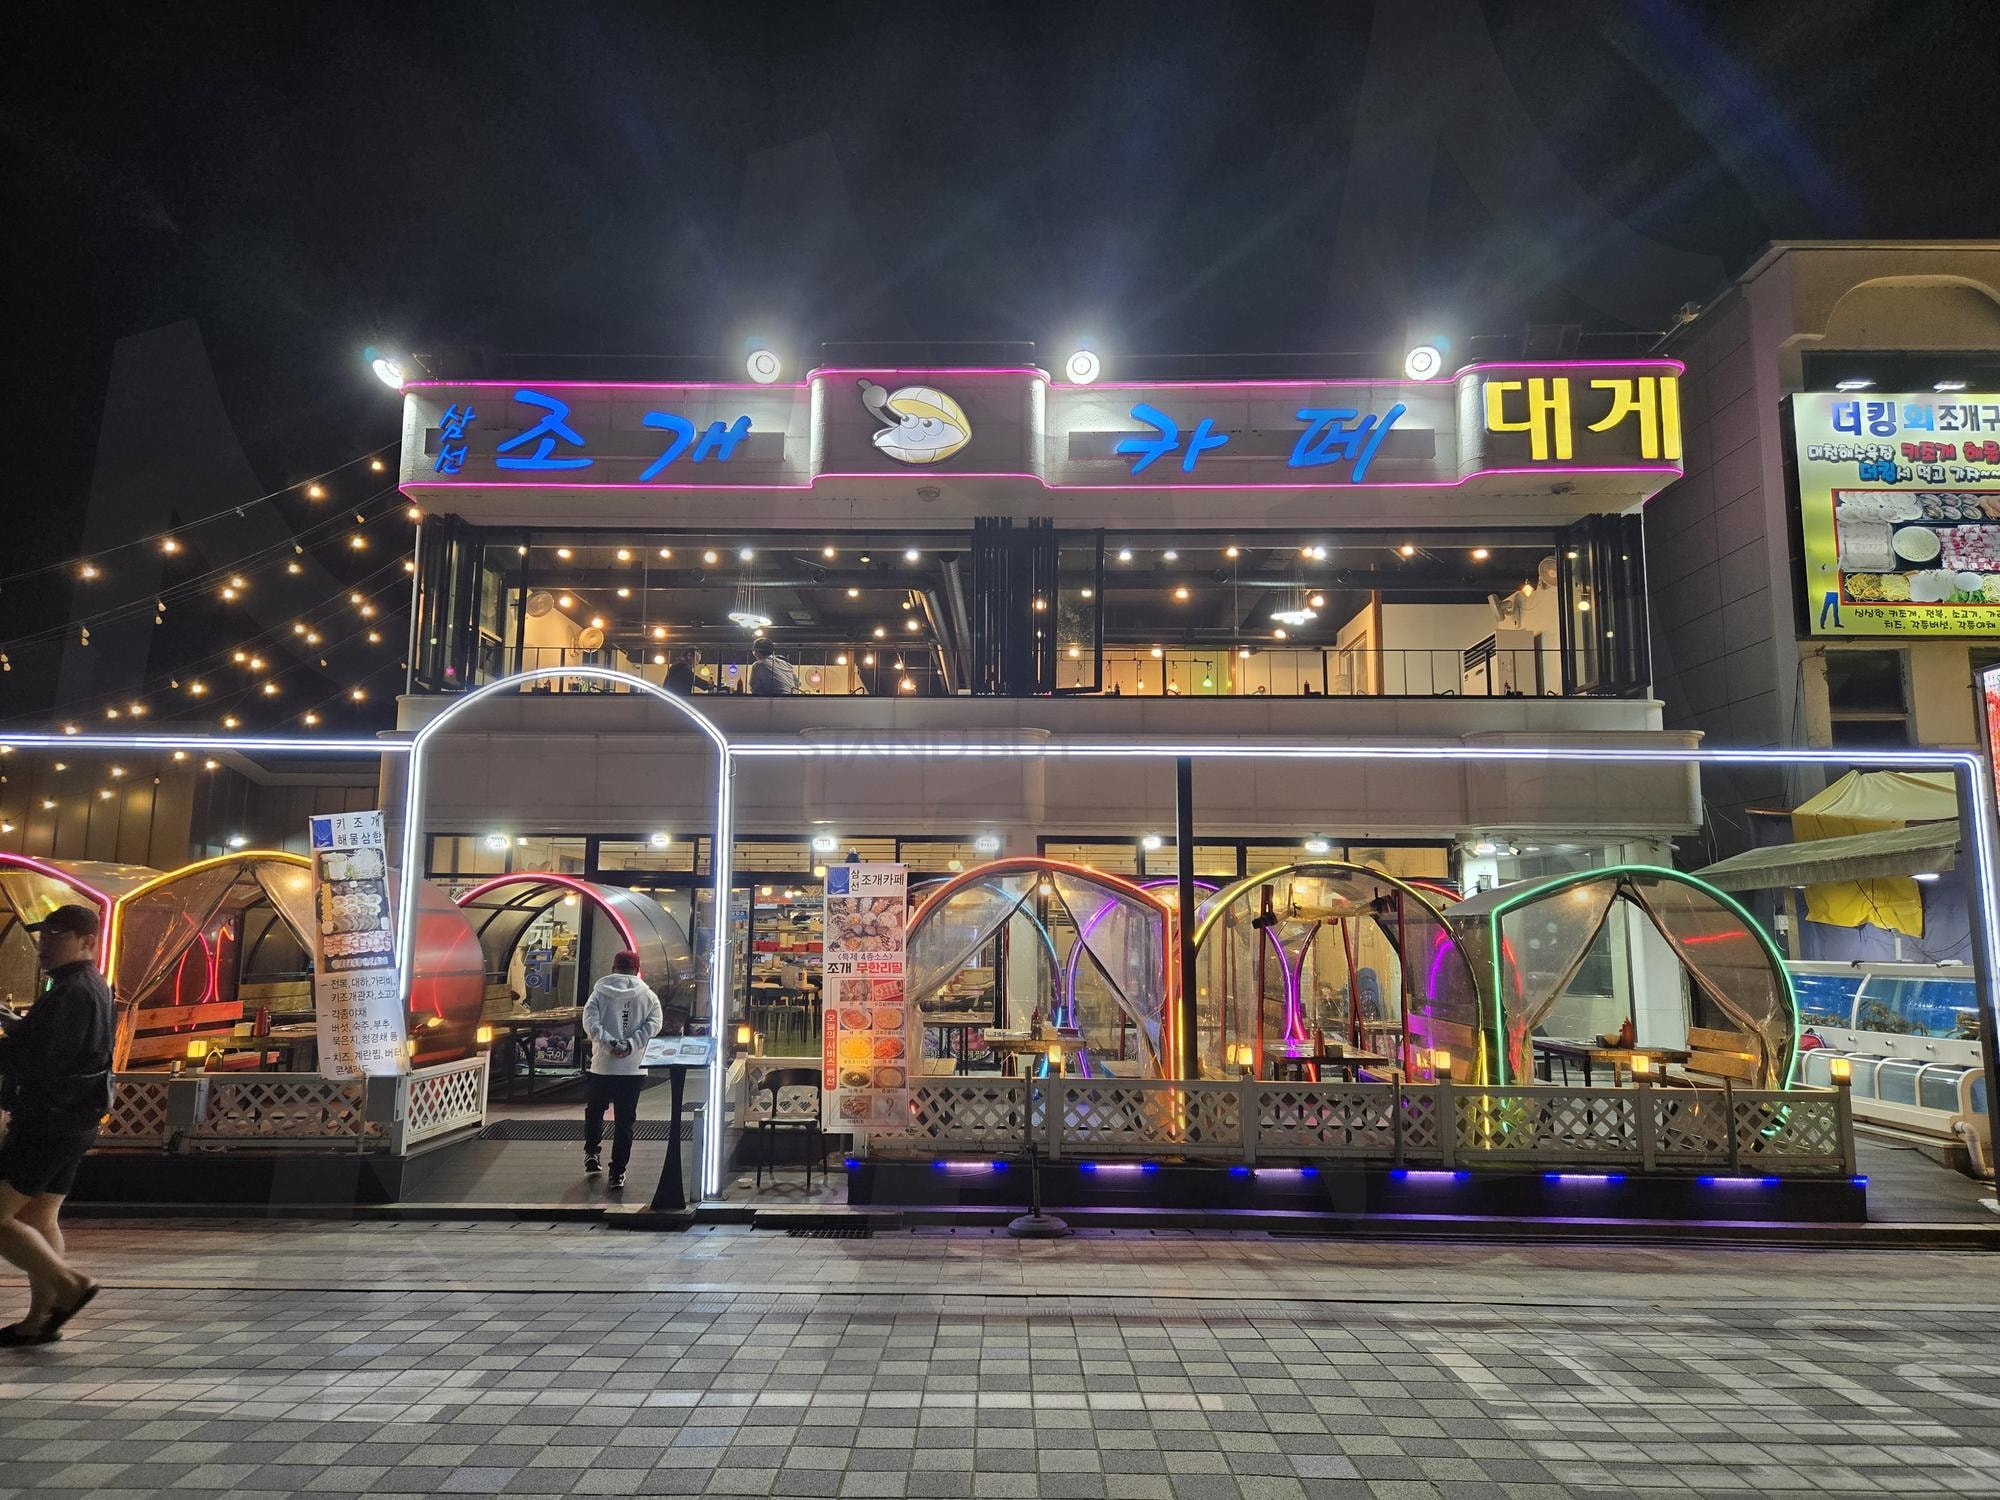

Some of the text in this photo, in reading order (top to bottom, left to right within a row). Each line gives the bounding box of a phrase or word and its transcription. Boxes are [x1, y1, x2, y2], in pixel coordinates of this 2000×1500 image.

[1484, 377, 1681, 460] 대게
[1831, 401, 1897, 437] 더킹
[1903, 403, 1934, 431] 회
[495, 389, 752, 482] 조개
[1807, 443, 1896, 463] 대천해수욕장
[1901, 441, 1957, 463] 키조개
[1916, 465, 1947, 484] 먹고
[336, 816, 380, 829] 키조개
[337, 831, 382, 846] 해물삼합
[861, 873, 904, 886] 조개카페
[827, 961, 903, 974] 조개 무한리필
[331, 1007, 367, 1020] 각종야채
[826, 1041, 835, 1066] 서비스
